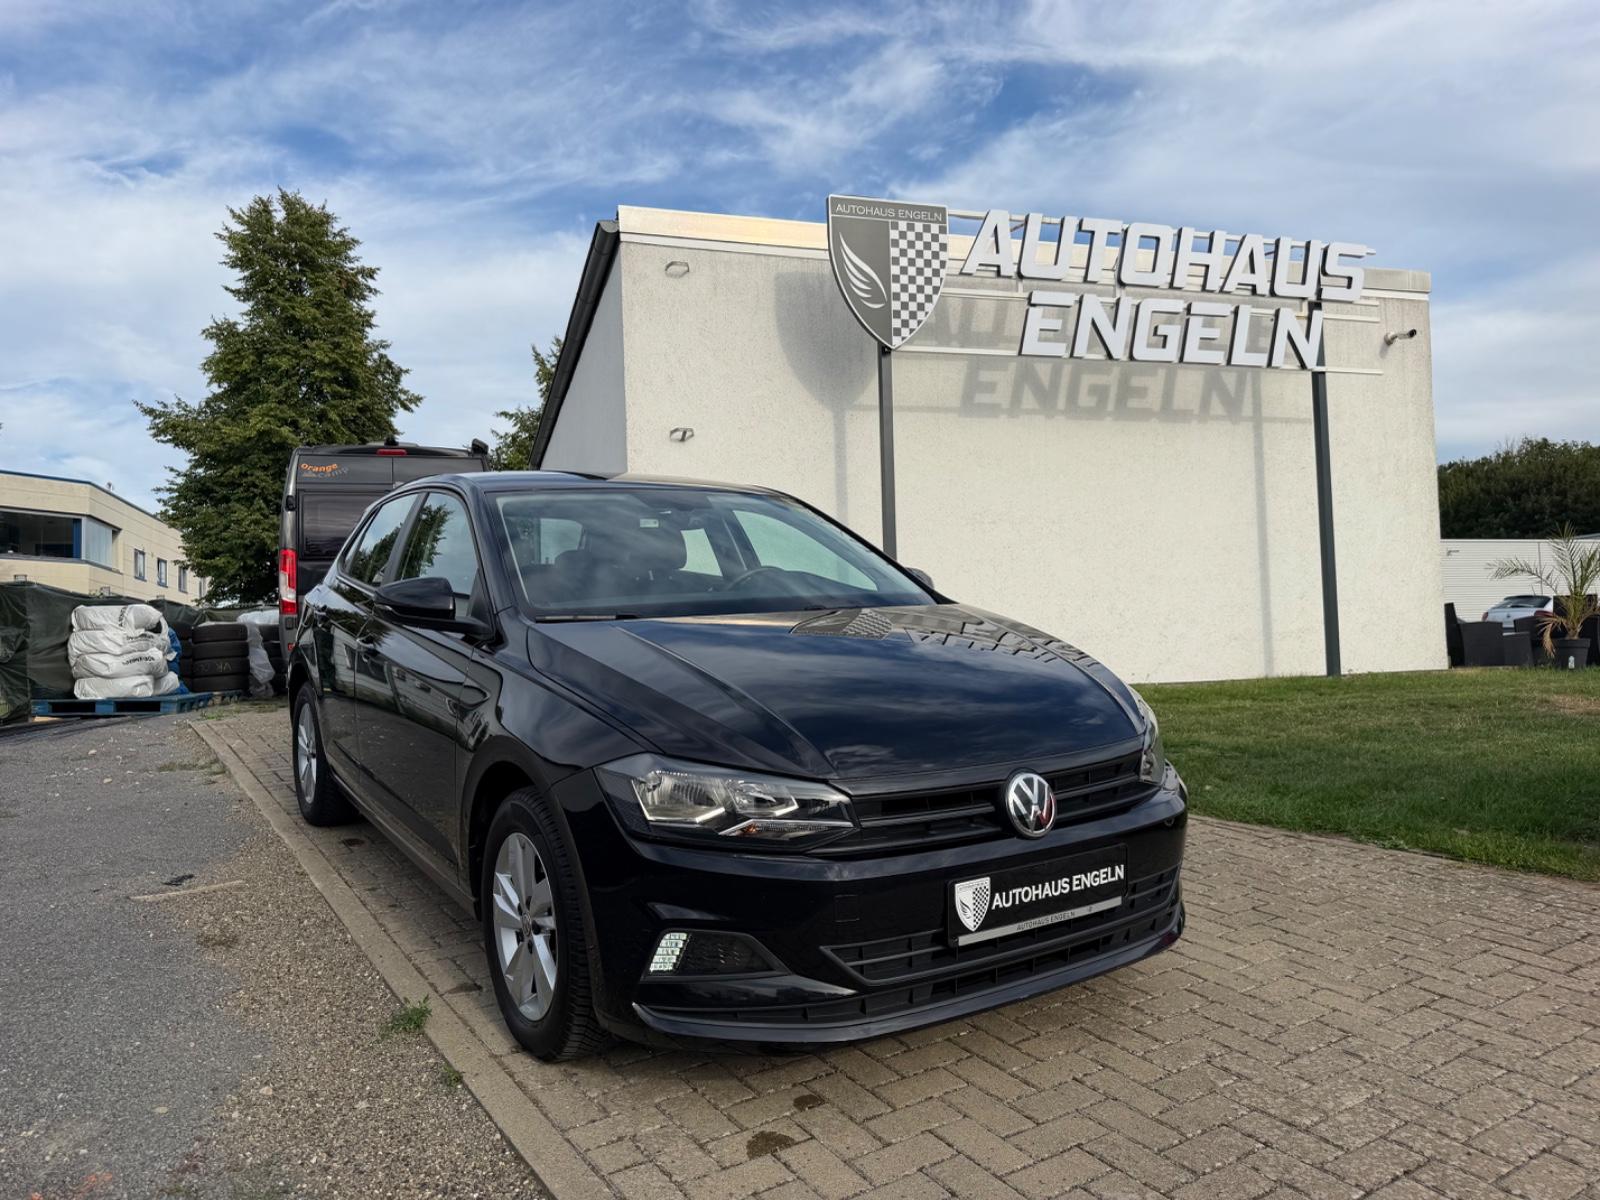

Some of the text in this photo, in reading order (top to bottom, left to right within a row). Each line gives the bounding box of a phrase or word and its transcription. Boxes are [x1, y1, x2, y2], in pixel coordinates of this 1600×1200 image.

[835, 203, 942, 221] AUTOHAUS ENGELN
[960, 209, 1368, 303] AUTOHAUS
[1019, 290, 1325, 370] ENGELN
[991, 864, 1125, 910] AUTOHAUS ENGELN
